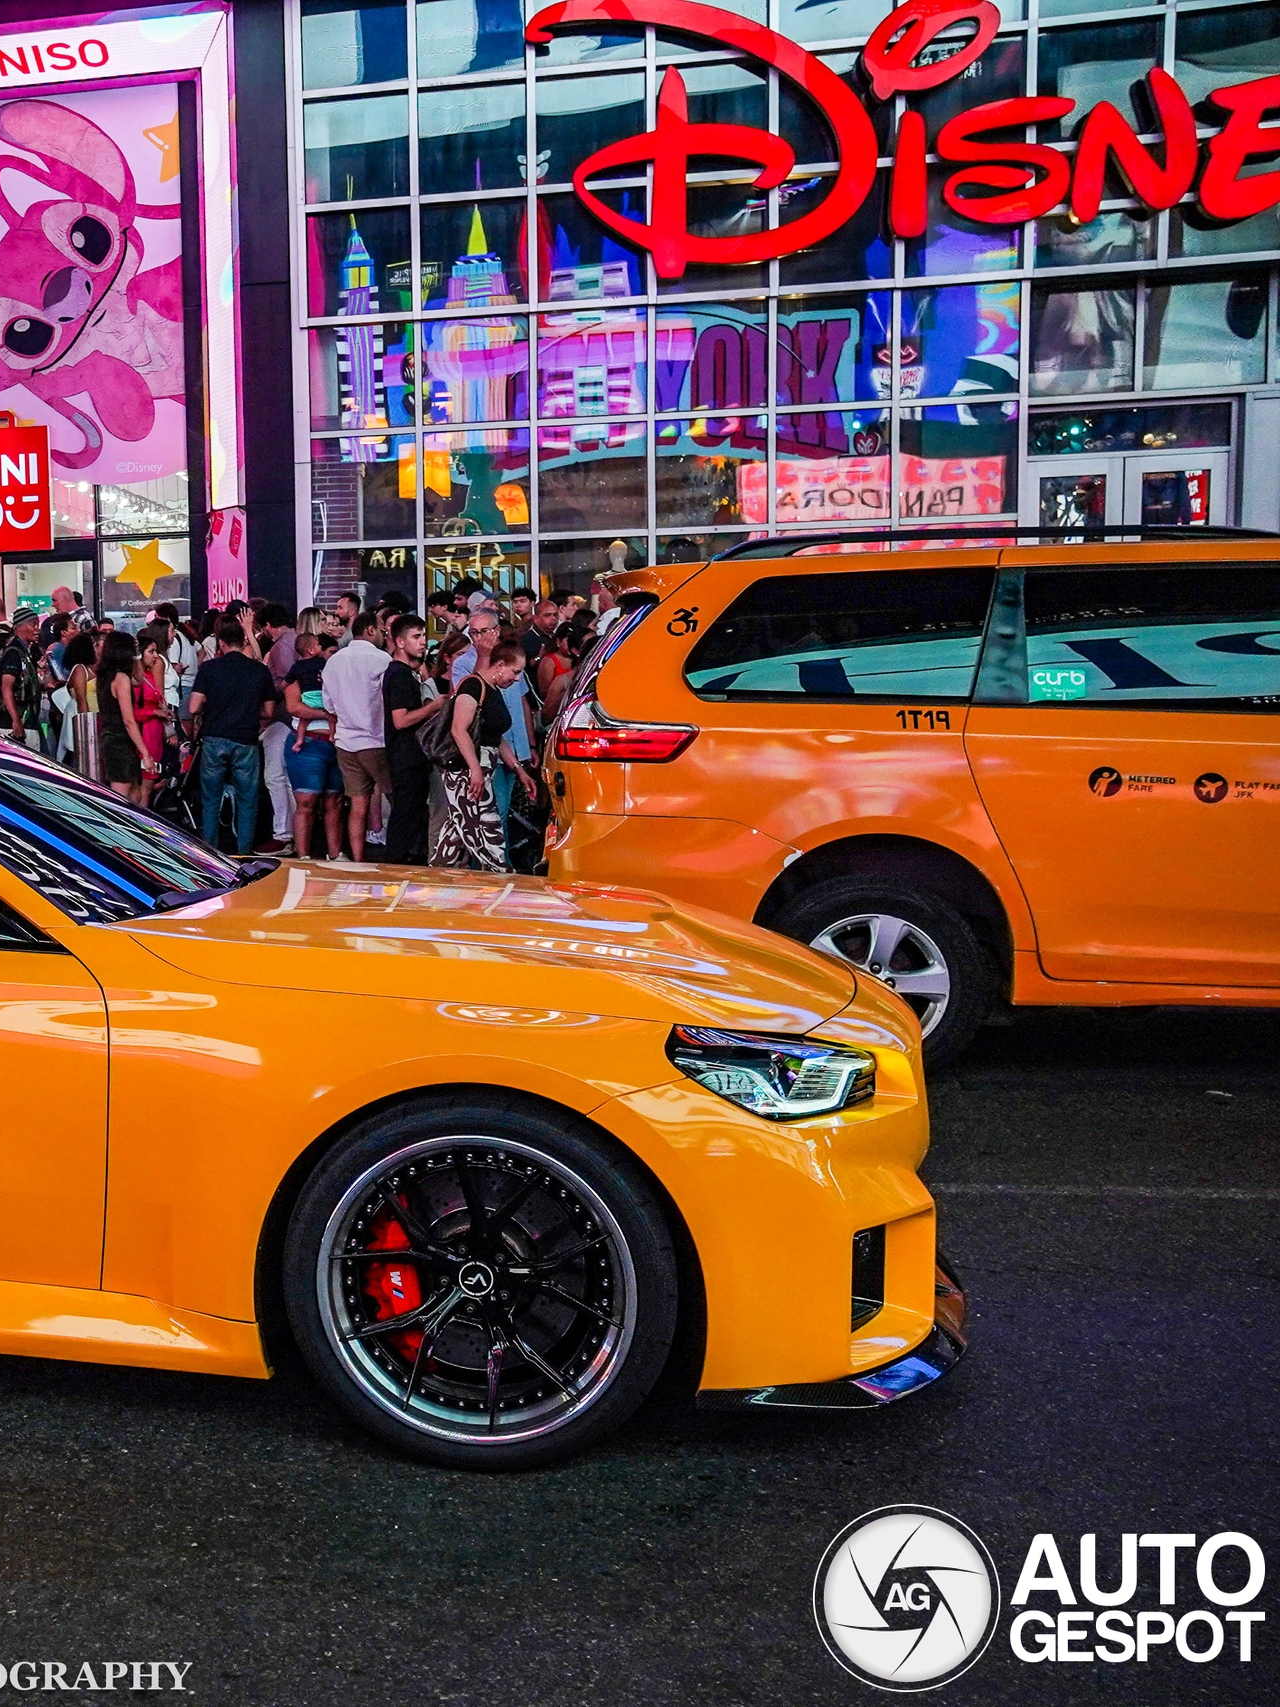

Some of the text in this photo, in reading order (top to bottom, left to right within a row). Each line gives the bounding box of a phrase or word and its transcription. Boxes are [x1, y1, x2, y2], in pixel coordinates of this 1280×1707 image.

[212, 577, 244, 603] BLIND
[1033, 671, 1085, 685] curb
[1128, 775, 1176, 784] METERED
[1234, 781, 1260, 790] FLAT
[1234, 791, 1253, 799] JFK
